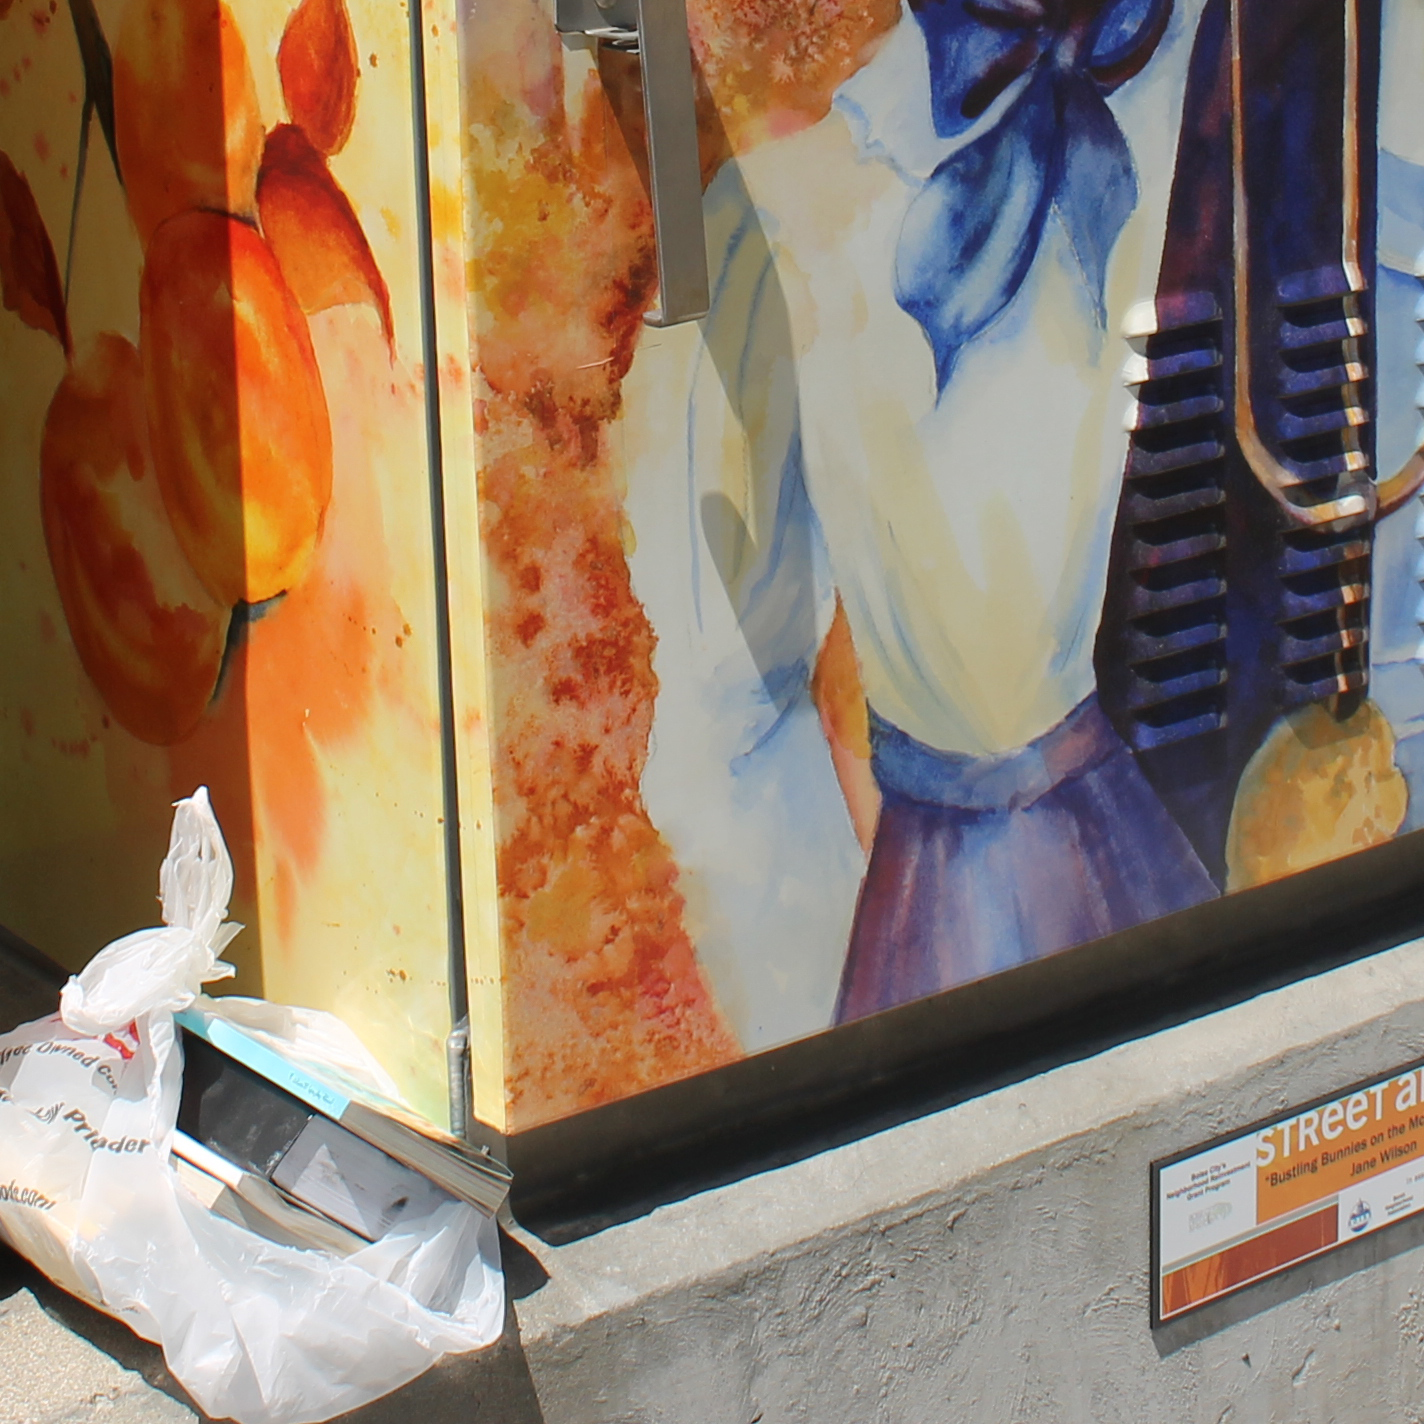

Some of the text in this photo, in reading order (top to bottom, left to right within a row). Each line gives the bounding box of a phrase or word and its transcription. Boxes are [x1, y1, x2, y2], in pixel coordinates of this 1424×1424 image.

[1321, 1139, 1368, 1167] Bunnies
[1371, 1132, 1384, 1146] on
[1388, 1123, 1405, 1139] the
[1350, 1140, 1418, 1177] Jane Wilson
